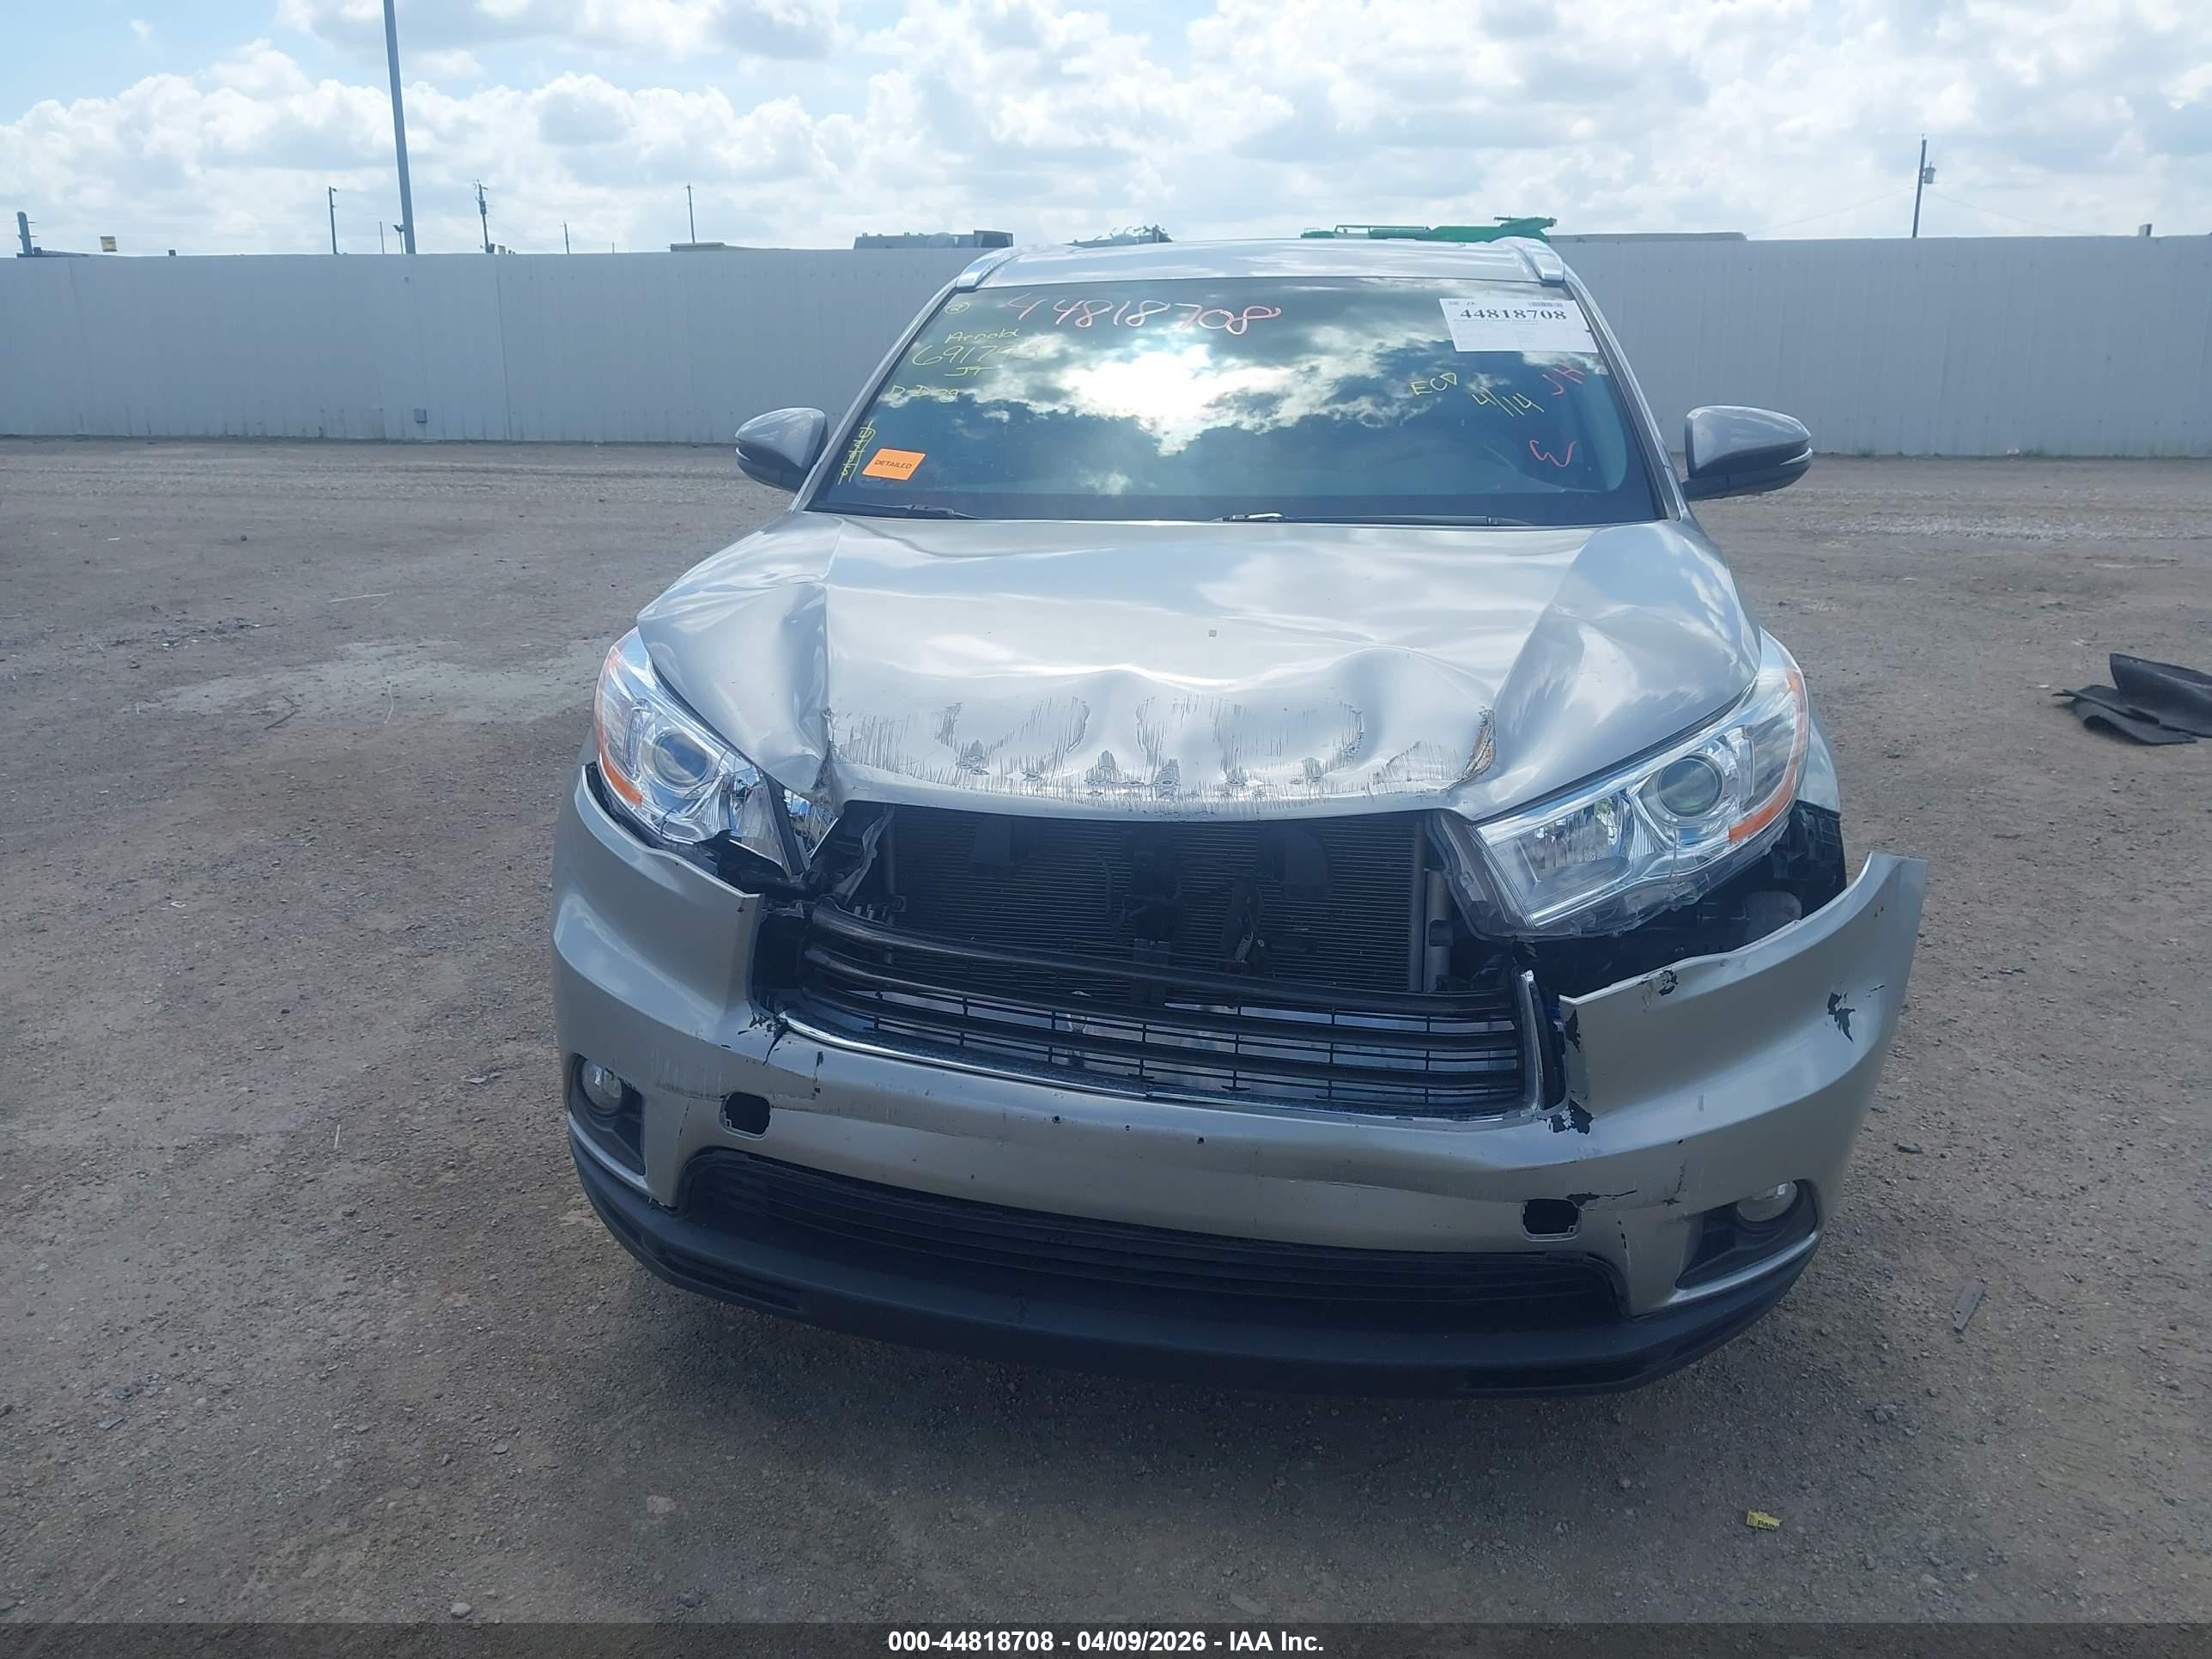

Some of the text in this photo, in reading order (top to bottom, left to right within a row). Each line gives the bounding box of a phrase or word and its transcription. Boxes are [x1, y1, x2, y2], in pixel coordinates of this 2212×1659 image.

[1006, 292, 1281, 335] 44818708
[1459, 308, 1568, 320] 44818708
[1471, 386, 1546, 417] 4/14
[874, 459, 913, 470] DETAILED
